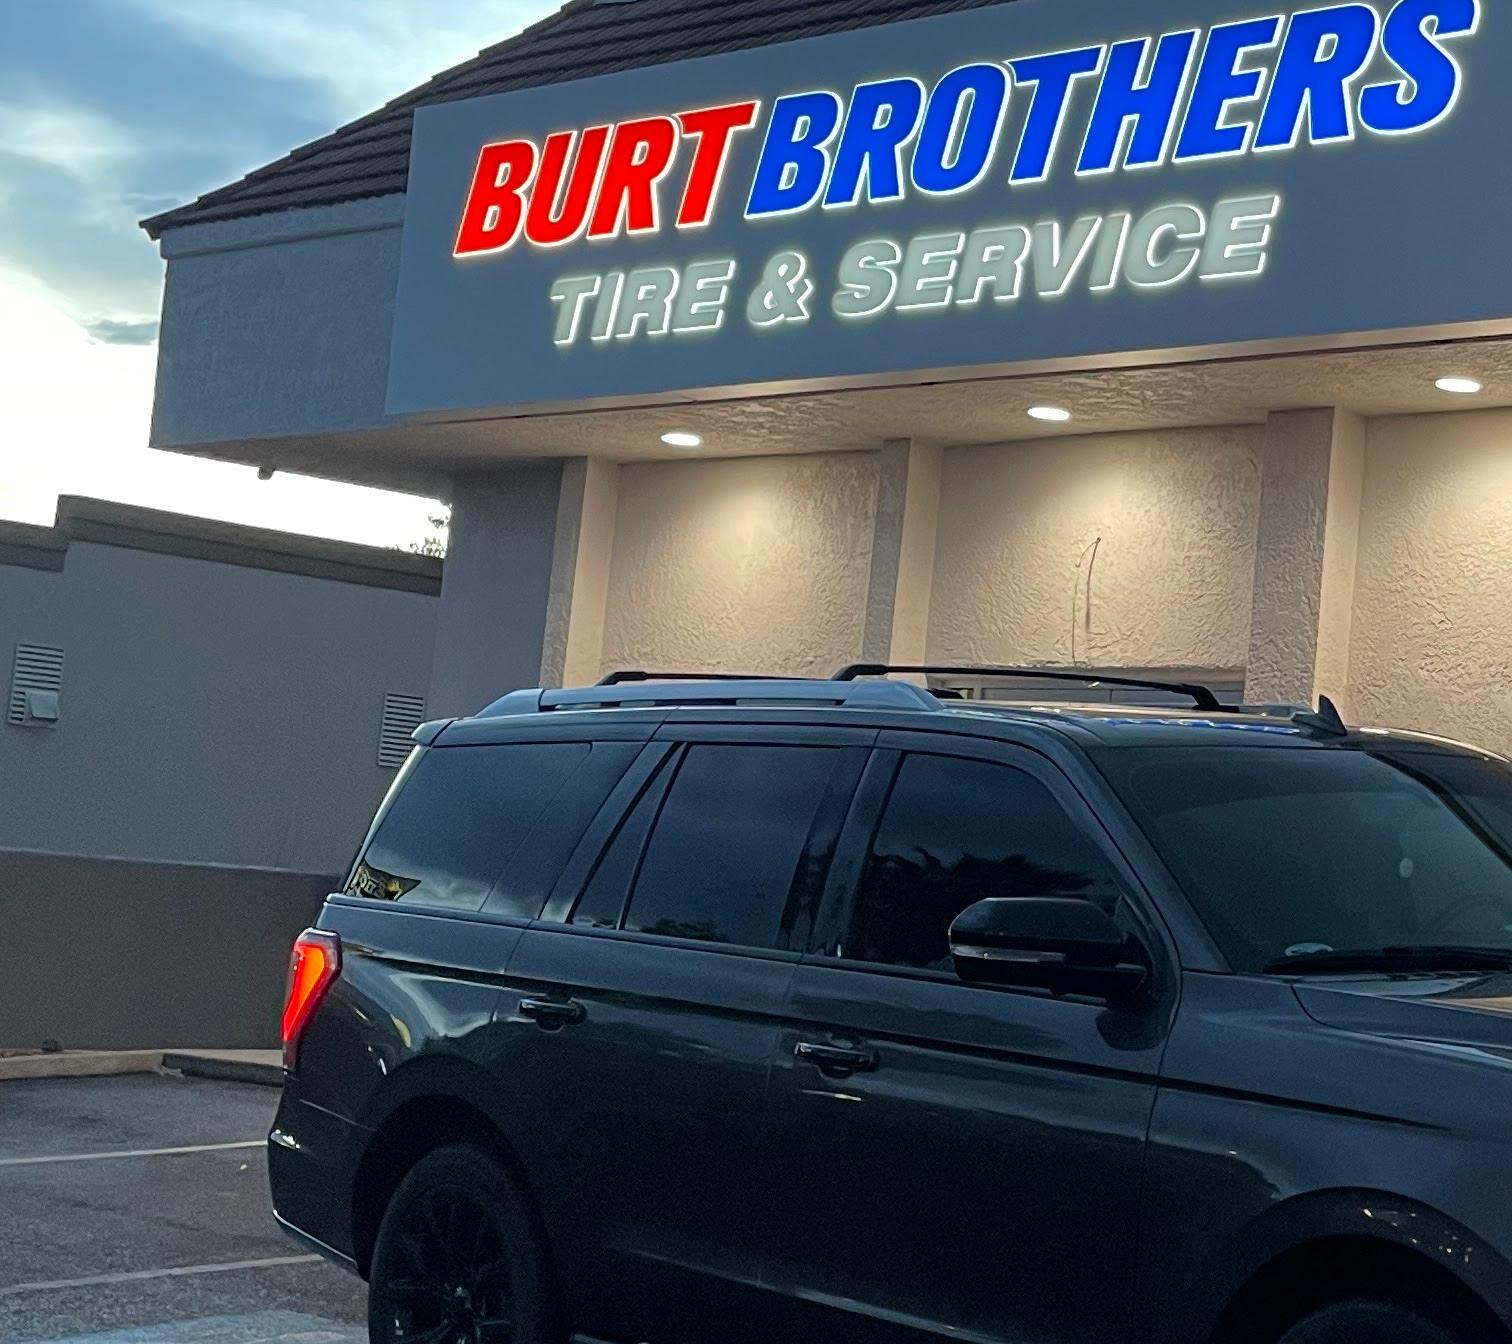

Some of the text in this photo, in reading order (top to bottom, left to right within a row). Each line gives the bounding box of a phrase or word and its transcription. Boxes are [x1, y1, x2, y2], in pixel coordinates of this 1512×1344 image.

[453, 99, 761, 257] BURT
[549, 194, 1280, 346] TIRE & SERVICE
